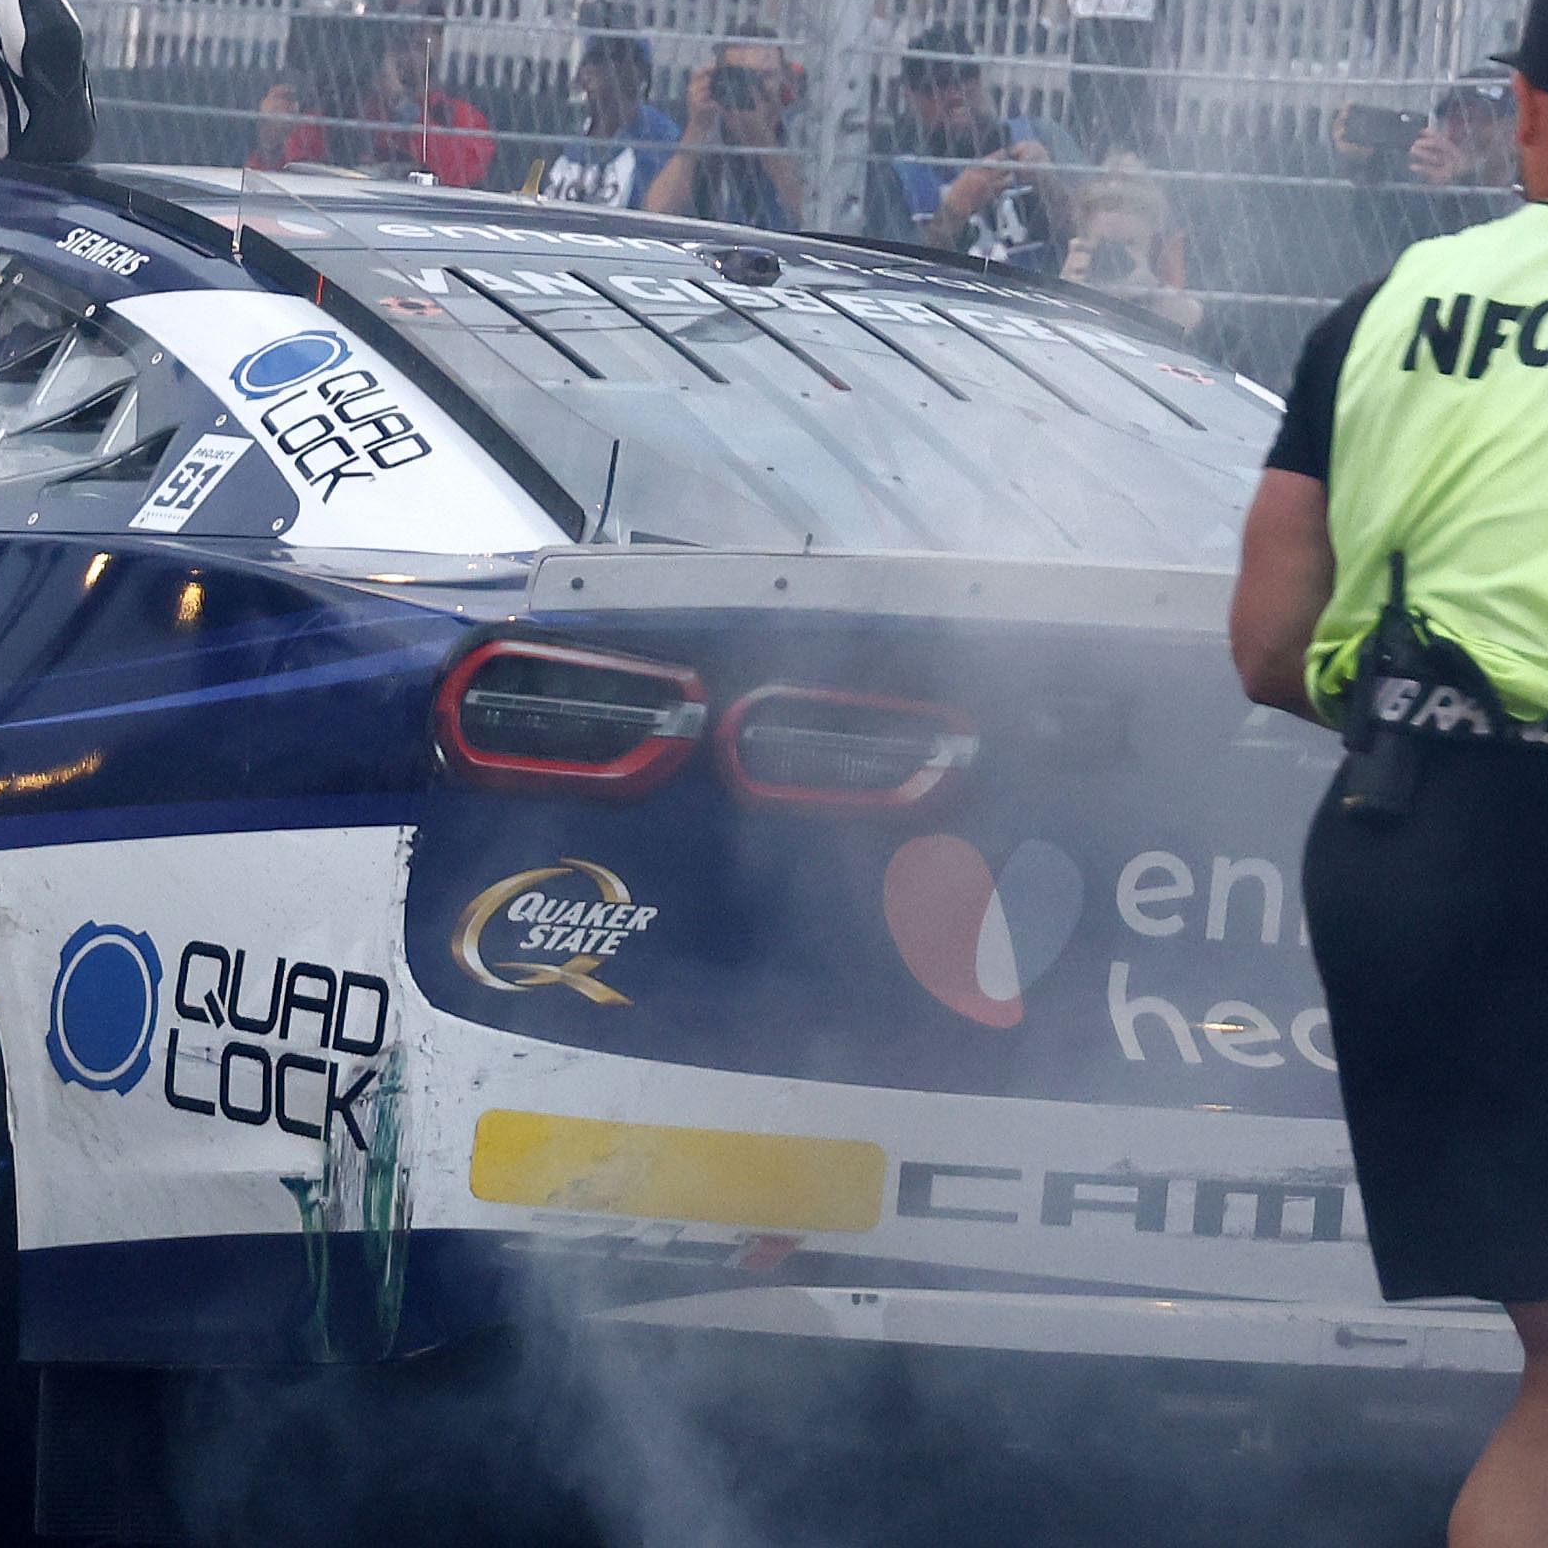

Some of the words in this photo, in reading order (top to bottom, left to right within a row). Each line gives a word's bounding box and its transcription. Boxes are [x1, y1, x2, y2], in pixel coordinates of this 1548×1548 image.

[55, 226, 151, 277] SIEMENS
[333, 266, 601, 299] VAN
[608, 274, 1149, 357] GISBERGEN
[195, 448, 235, 460] PROJECT
[260, 389, 373, 505] LOCK
[317, 369, 433, 469] QUAD
[153, 461, 222, 508] 91
[507, 891, 658, 931] QUAKER
[519, 923, 629, 955] STATE
[174, 940, 390, 1058] QUAD
[164, 1027, 378, 1151] LOCK
